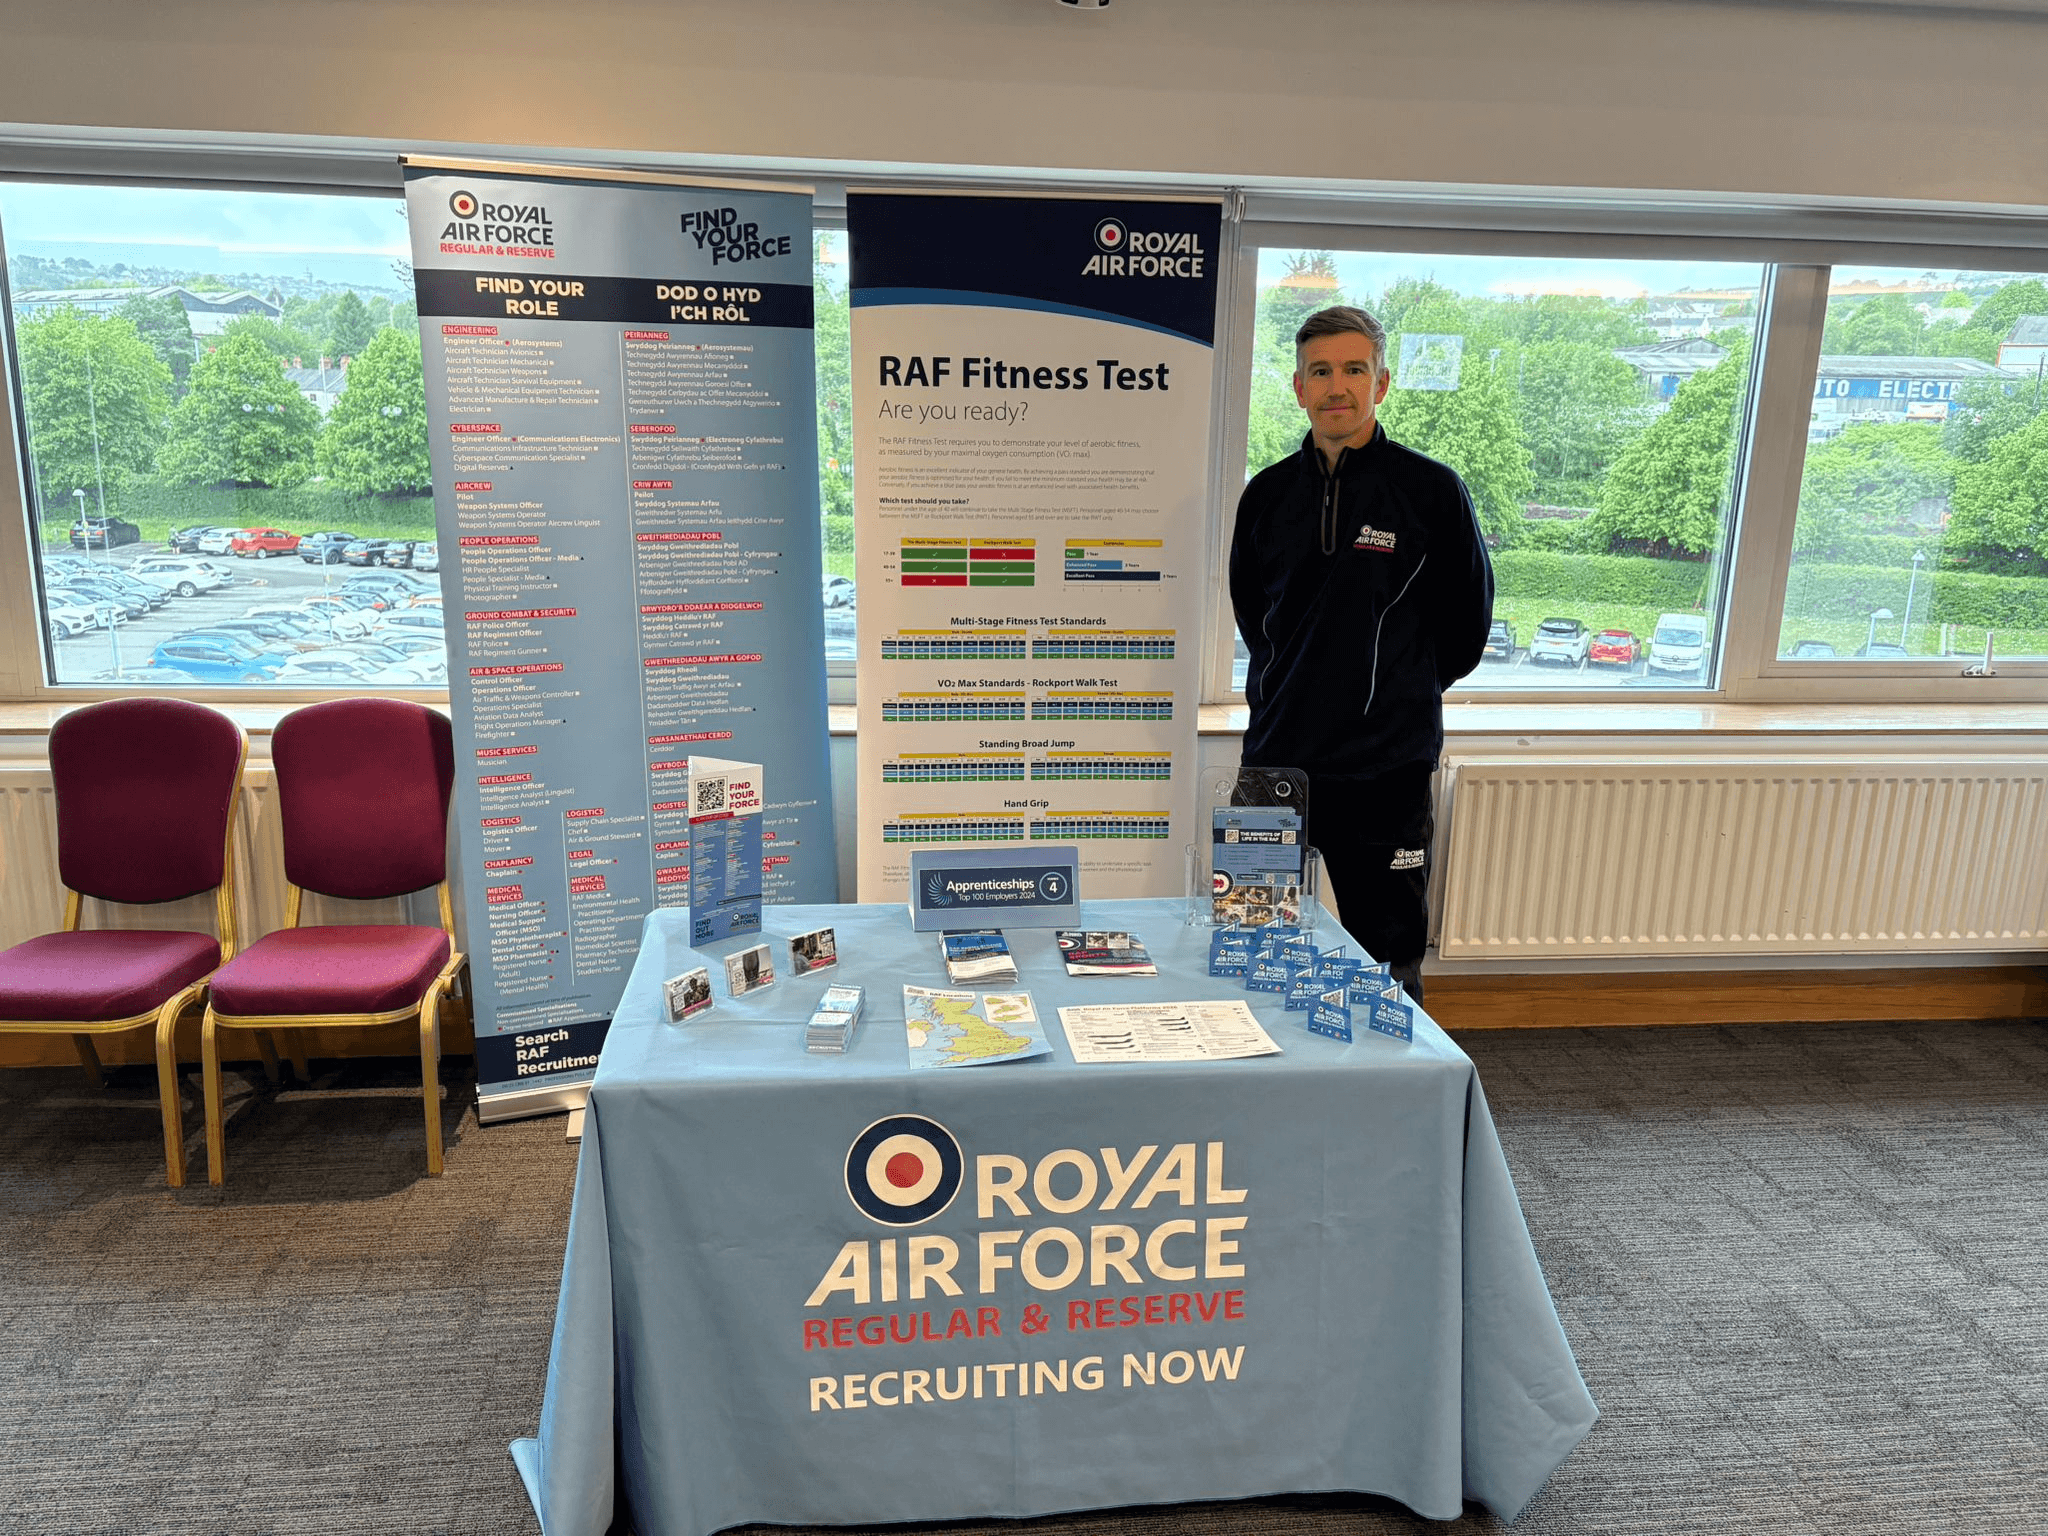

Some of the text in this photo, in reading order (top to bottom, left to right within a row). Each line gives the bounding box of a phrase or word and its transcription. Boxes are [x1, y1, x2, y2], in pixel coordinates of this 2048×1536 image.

[482, 203, 552, 224] ROYAL
[681, 208, 737, 232] FIND
[440, 222, 553, 245] AIR FORCE
[692, 223, 758, 249] YOUR
[1129, 232, 1204, 254] ROYAL
[440, 243, 555, 258] REGULAR & RESERVE
[712, 236, 791, 266] FORCE
[1081, 255, 1204, 278] AIR FORCE
[476, 277, 584, 296] FIND YOUR
[657, 285, 761, 302] DOD O HYD
[506, 300, 558, 315] ROLE
[671, 304, 749, 321] I'CH RÔL
[442, 326, 497, 335] ENGINEERING
[625, 332, 669, 340] PEIRIANNEG
[513, 339, 562, 348] (Aerosystems)
[880, 356, 1169, 391] RAF Fitness Test
[879, 400, 1029, 426] Are you ready?
[630, 425, 675, 433] SEIBEROFOD
[454, 464, 477, 472] Digital
[1371, 530, 1396, 540] ROYAL
[460, 536, 538, 545] PEOPLE OPERATIONS
[1370, 538, 1395, 548] FORCE
[466, 612, 499, 620] GROUND
[501, 611, 532, 619] COMBAT
[951, 617, 1004, 627] Multi-Stage
[1006, 617, 1037, 626] Fitness
[1060, 617, 1106, 625] Standards
[492, 666, 515, 674] SPACE
[517, 664, 562, 673] OPERATIONS
[1033, 679, 1074, 688] Rockport
[708, 731, 731, 739] CERDD
[979, 739, 1075, 749] Standing Broad Jump
[477, 746, 537, 757] MUSIC SERVICES
[479, 774, 531, 784] INTELLIGENCE
[729, 782, 751, 791] FIND
[729, 790, 754, 800] YOUR
[653, 802, 686, 810] LOGISTEG
[729, 799, 759, 809] FORCE
[1004, 799, 1049, 809] Hand Grip
[567, 809, 603, 817] LOGISTICS
[482, 817, 520, 826] LOGISTICS
[485, 858, 533, 868] CHAPLAINCY
[486, 869, 517, 878] Chaplain
[571, 876, 604, 884] MEDICAL
[487, 886, 521, 894] MEDICAL
[571, 884, 605, 892] SERVICES
[947, 879, 1035, 893] Apprenticeships
[1050, 882, 1057, 893] 4
[488, 894, 522, 902] SERVICES
[958, 893, 970, 902] Top
[986, 892, 1018, 901] Employers
[1019, 891, 1035, 899] 2024
[516, 1029, 568, 1047] Search
[517, 1046, 549, 1061] RAF
[518, 1054, 601, 1075] Recruitme
[975, 1141, 1248, 1219] ROYAL
[804, 1216, 1248, 1307] AIR FORCE
[803, 1290, 1245, 1351] REGULAR & RESERVE
[810, 1346, 1246, 1412] RECRUITING NOW
